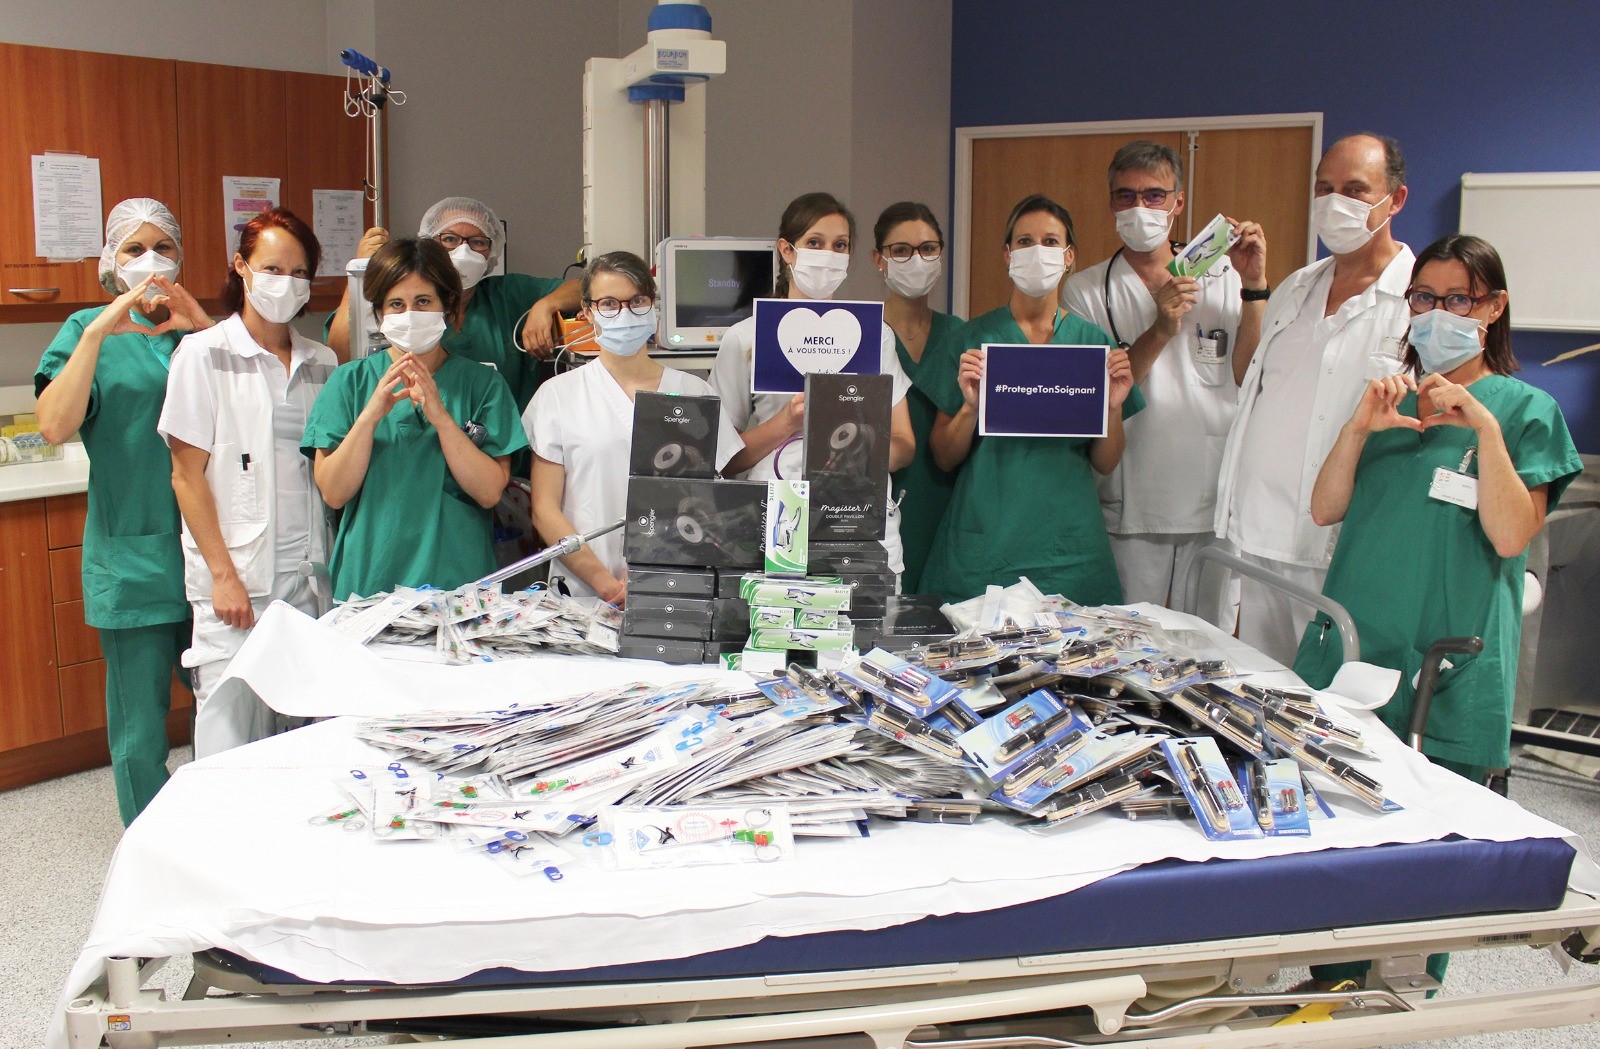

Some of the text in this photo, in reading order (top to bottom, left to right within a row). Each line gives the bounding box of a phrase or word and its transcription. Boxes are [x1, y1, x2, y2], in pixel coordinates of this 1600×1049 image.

[708, 278, 741, 289] Standby
[803, 336, 834, 345] MERCI
[788, 346, 794, 354] À
[995, 384, 1096, 396] #ProtegeTonSoignant
[839, 394, 865, 403] Spengler
[664, 415, 691, 425] Spengler
[820, 504, 862, 515] Magister
[648, 508, 656, 535] Spengler
